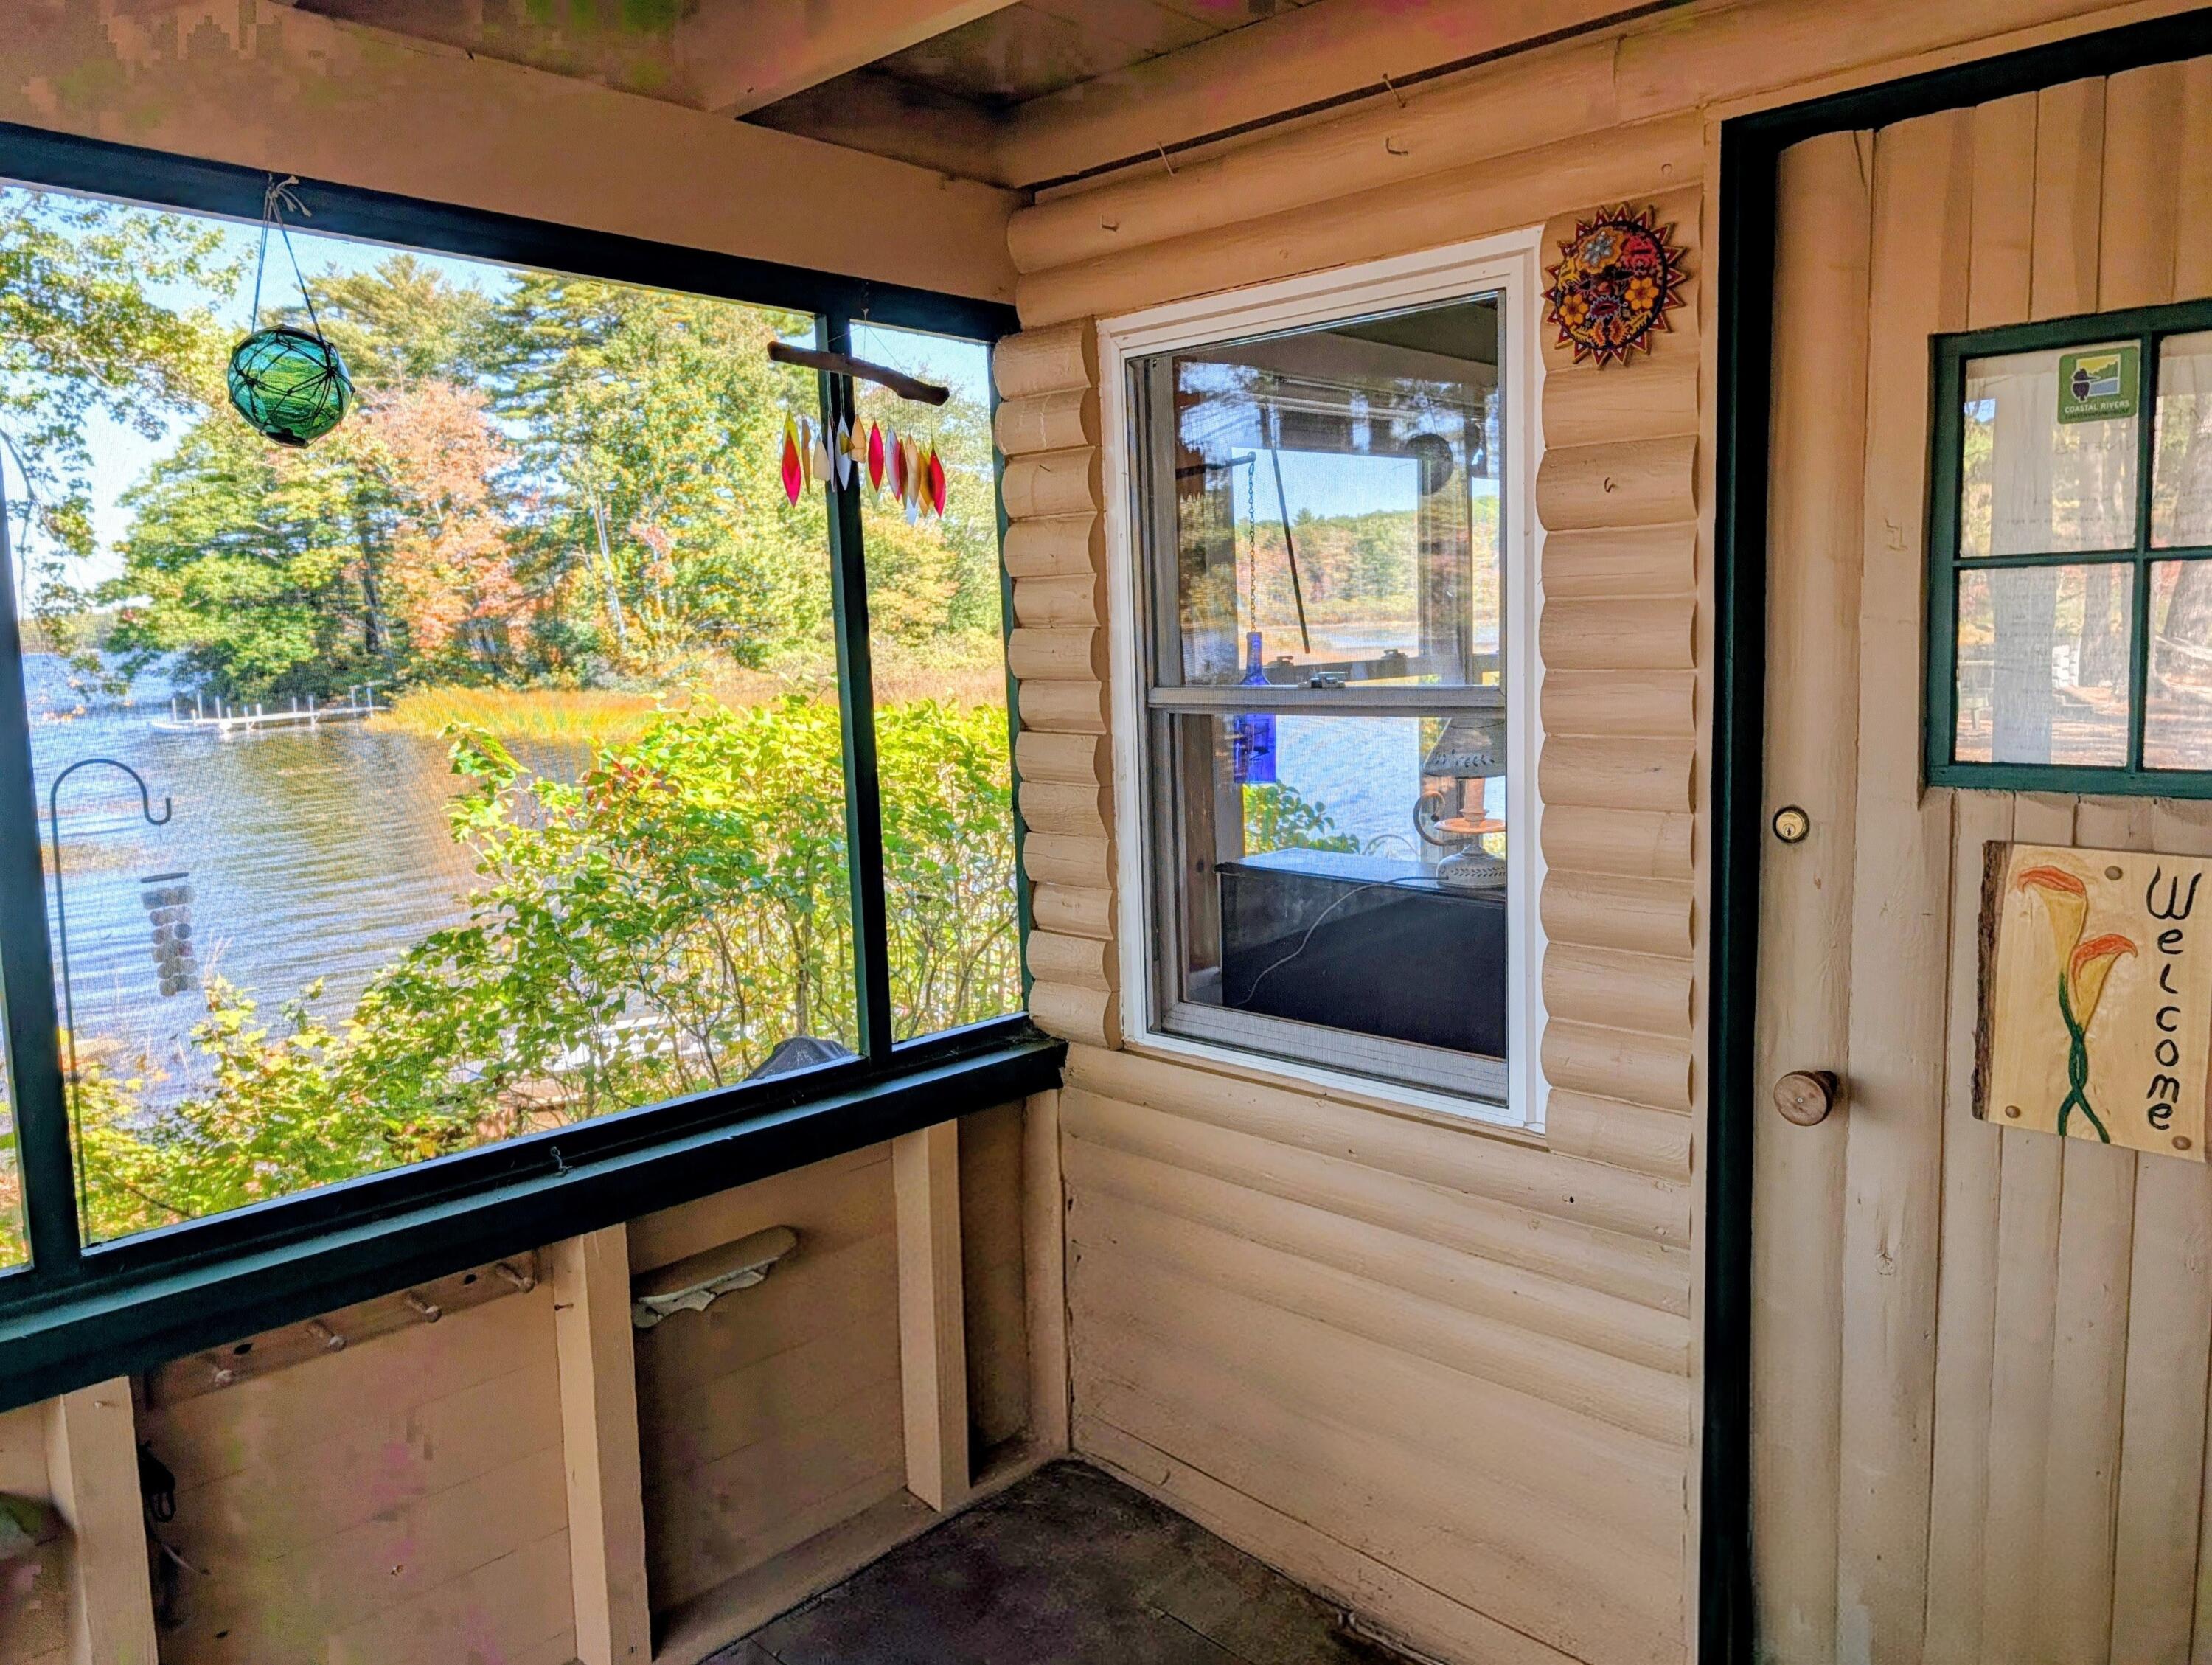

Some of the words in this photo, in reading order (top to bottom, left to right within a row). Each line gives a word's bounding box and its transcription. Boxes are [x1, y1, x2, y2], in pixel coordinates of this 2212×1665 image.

[2065, 403, 2098, 414] COASTAL
[2101, 400, 2130, 409] RIVERS
[2146, 865, 2202, 1130] Welcome
